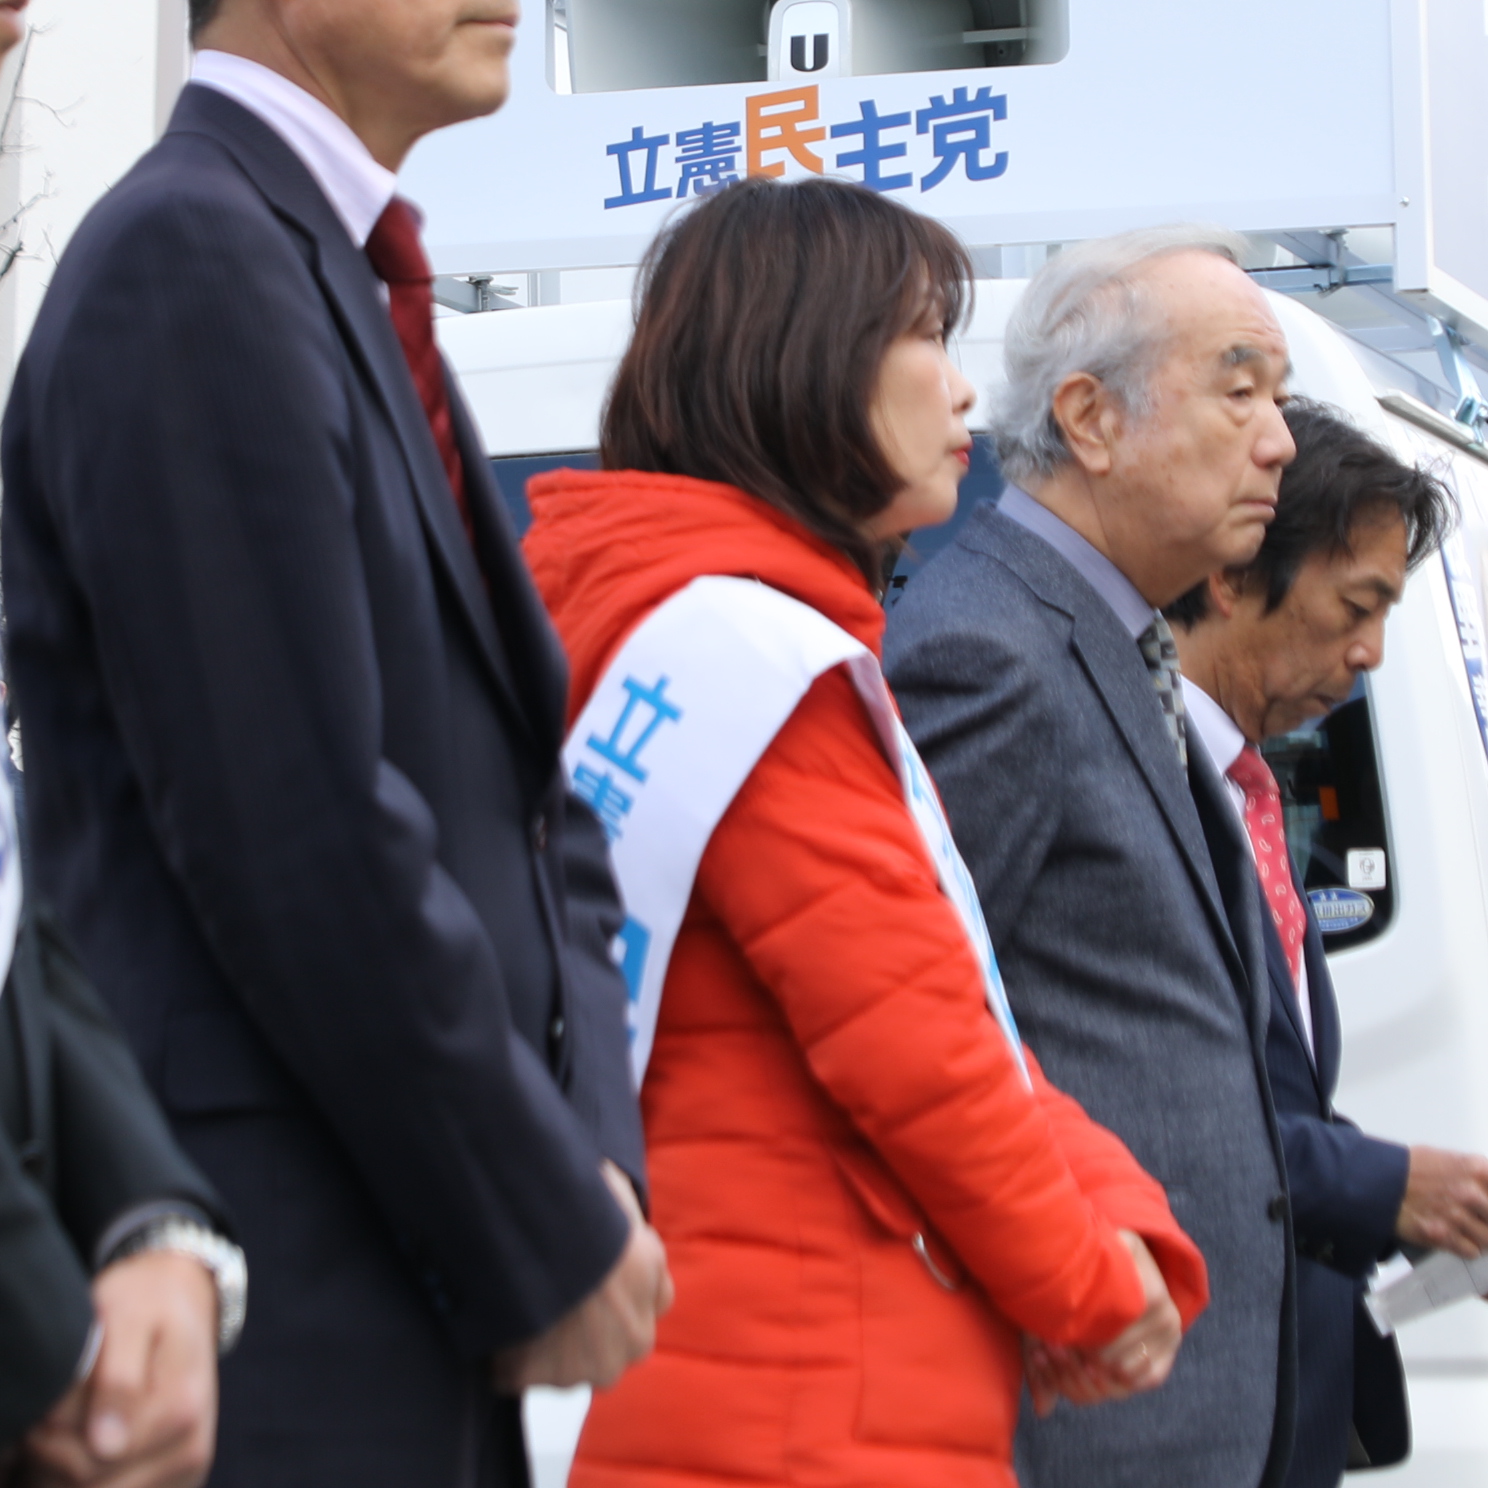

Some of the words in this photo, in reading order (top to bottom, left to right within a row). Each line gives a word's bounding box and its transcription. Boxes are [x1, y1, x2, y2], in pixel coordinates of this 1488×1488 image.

[603, 84, 1010, 210] 立憲民主党
